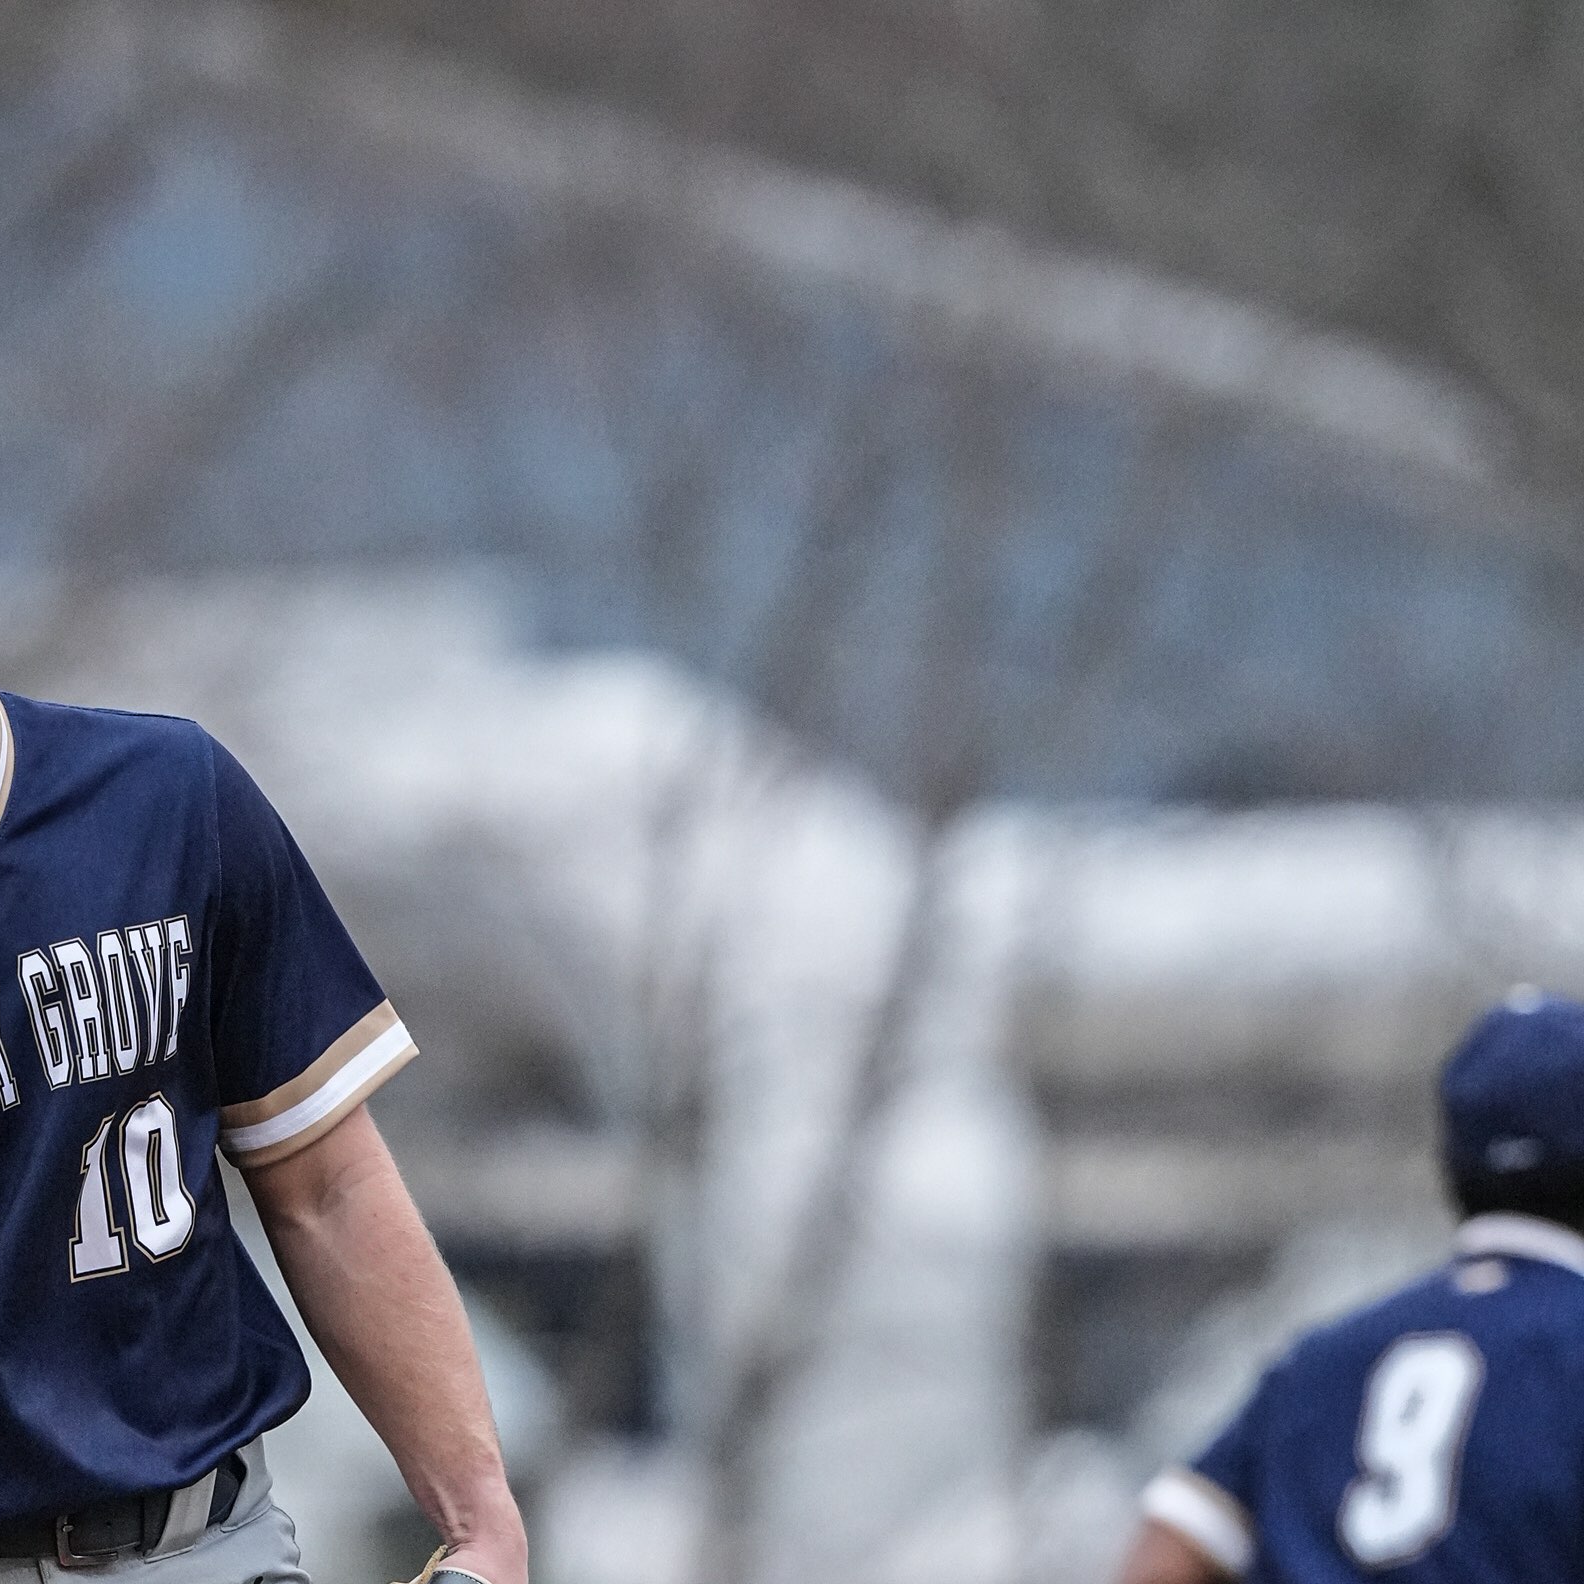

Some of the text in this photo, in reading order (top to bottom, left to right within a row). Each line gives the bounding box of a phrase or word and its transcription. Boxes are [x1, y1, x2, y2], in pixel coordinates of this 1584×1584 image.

[18, 914, 193, 1091] GROVE
[68, 1091, 196, 1283] 10
[1336, 1328, 1487, 1572] 9
